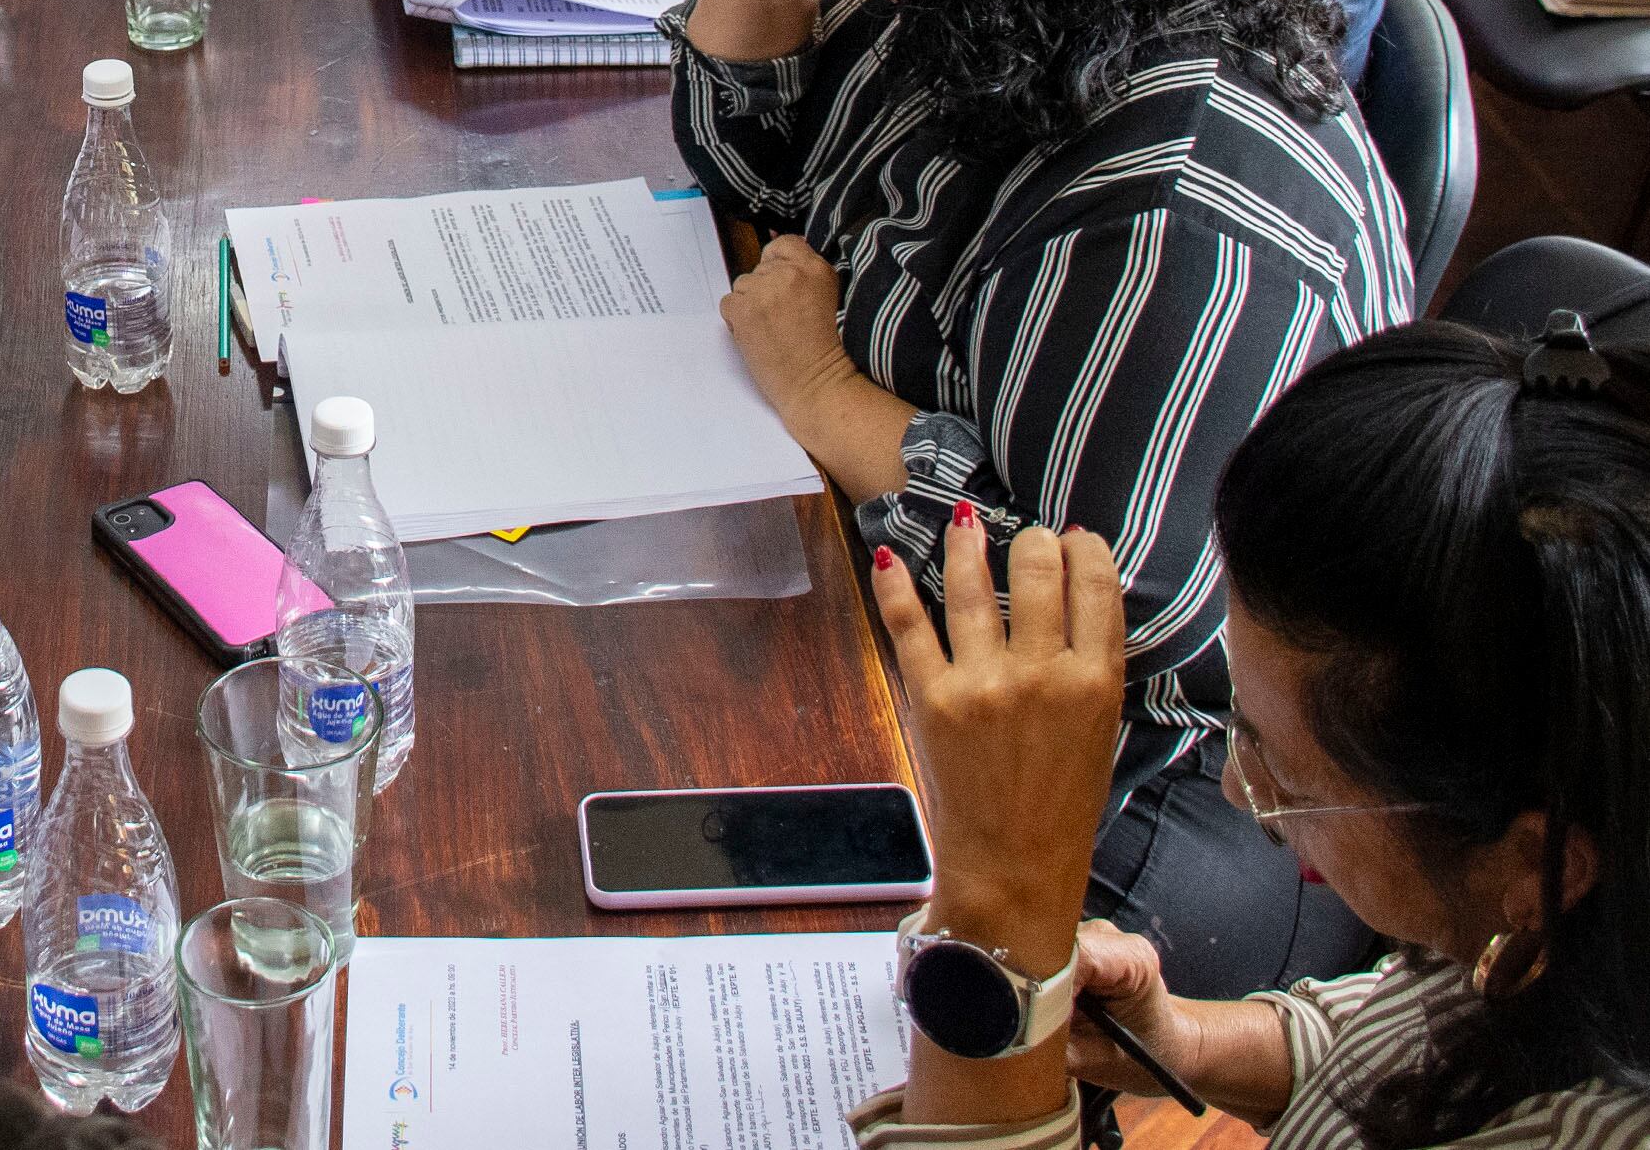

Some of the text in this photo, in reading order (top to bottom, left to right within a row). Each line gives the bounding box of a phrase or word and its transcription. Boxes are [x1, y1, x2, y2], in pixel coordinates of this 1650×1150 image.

[33, 988, 96, 1026] xuma
[448, 1012, 456, 1020] de
[66, 1021, 91, 1033] Mesa
[797, 1023, 807, 1033] DE
[396, 1002, 406, 1075] Concejo Deliberante
[448, 1021, 456, 1051] noviembre
[448, 1053, 456, 1061] de
[572, 1067, 583, 1087] INTER
[573, 1089, 584, 1113] LABOR
[574, 1114, 585, 1125] DE
